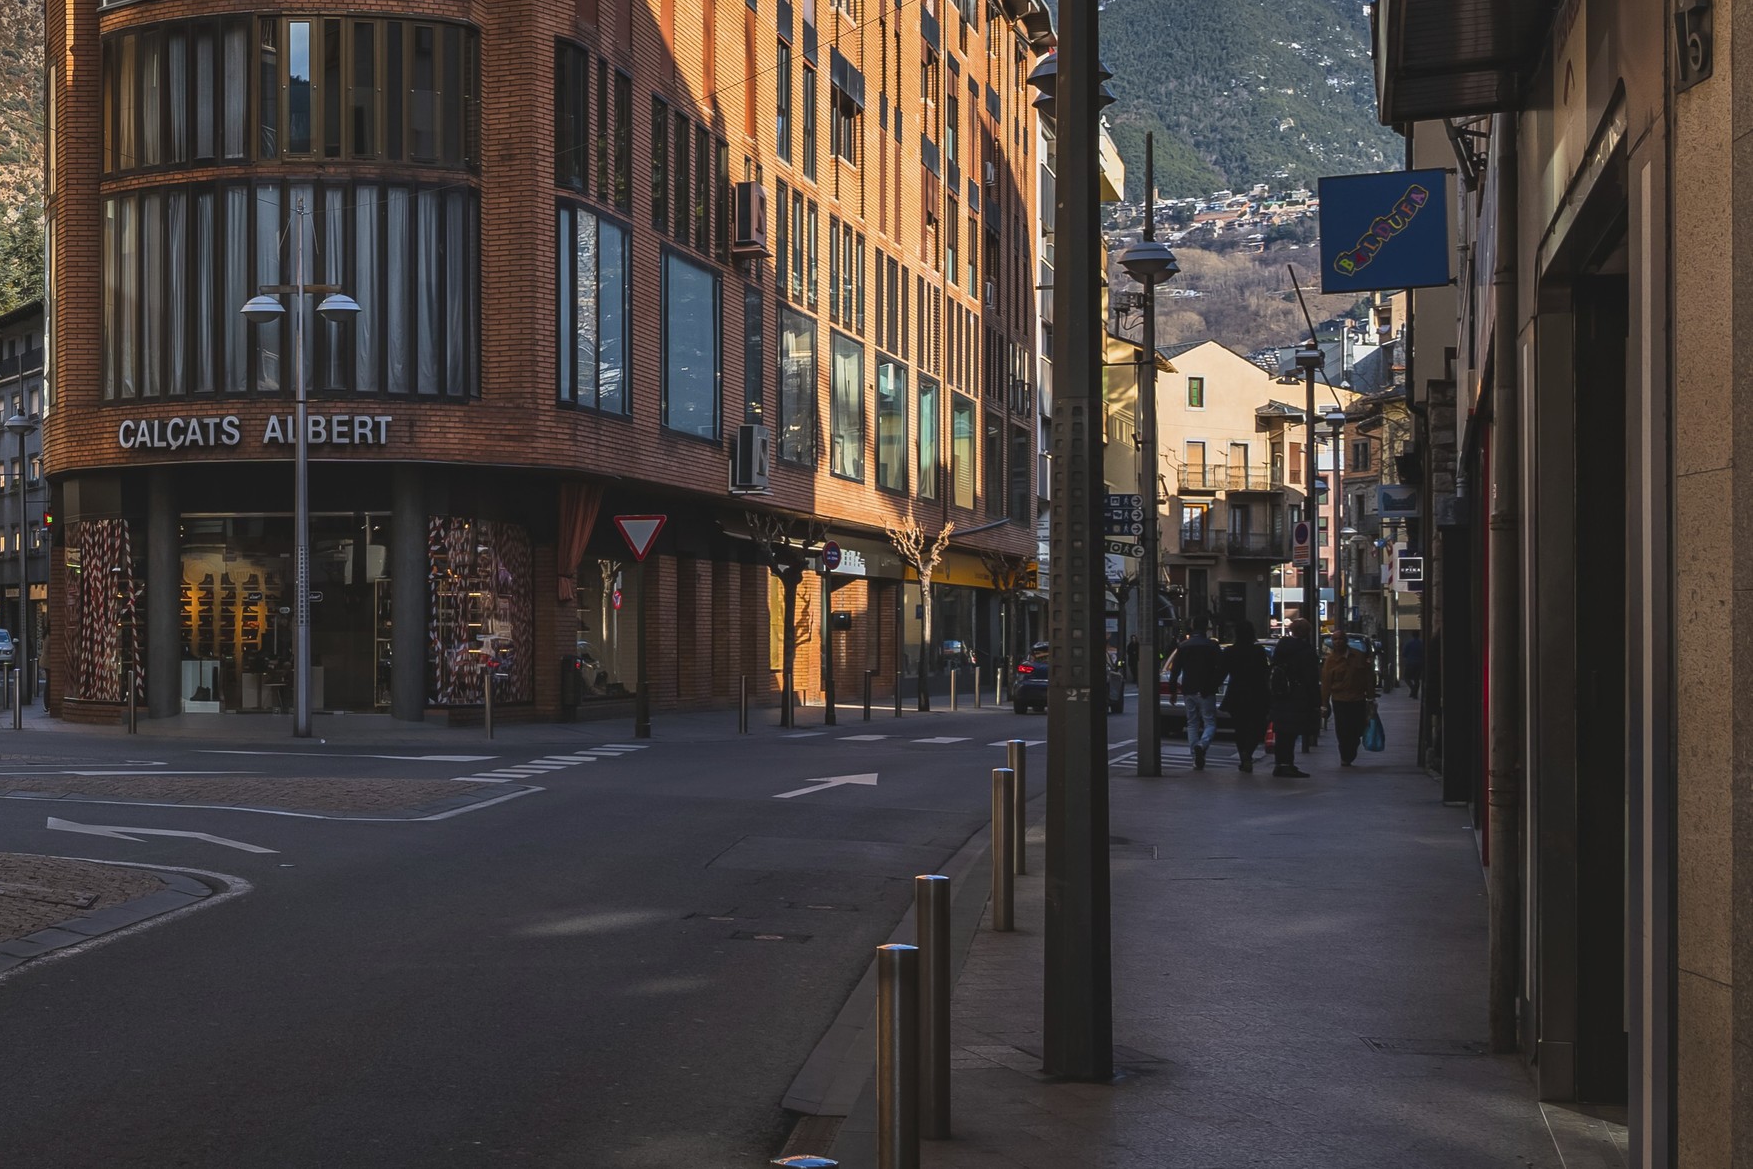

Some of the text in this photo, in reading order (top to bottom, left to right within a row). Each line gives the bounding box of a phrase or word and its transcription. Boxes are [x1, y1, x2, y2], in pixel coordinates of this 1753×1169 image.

[1338, 191, 1426, 272] BALDUFA
[119, 415, 393, 450] CALÇATS ALBERT
[1065, 688, 1091, 702] 27
